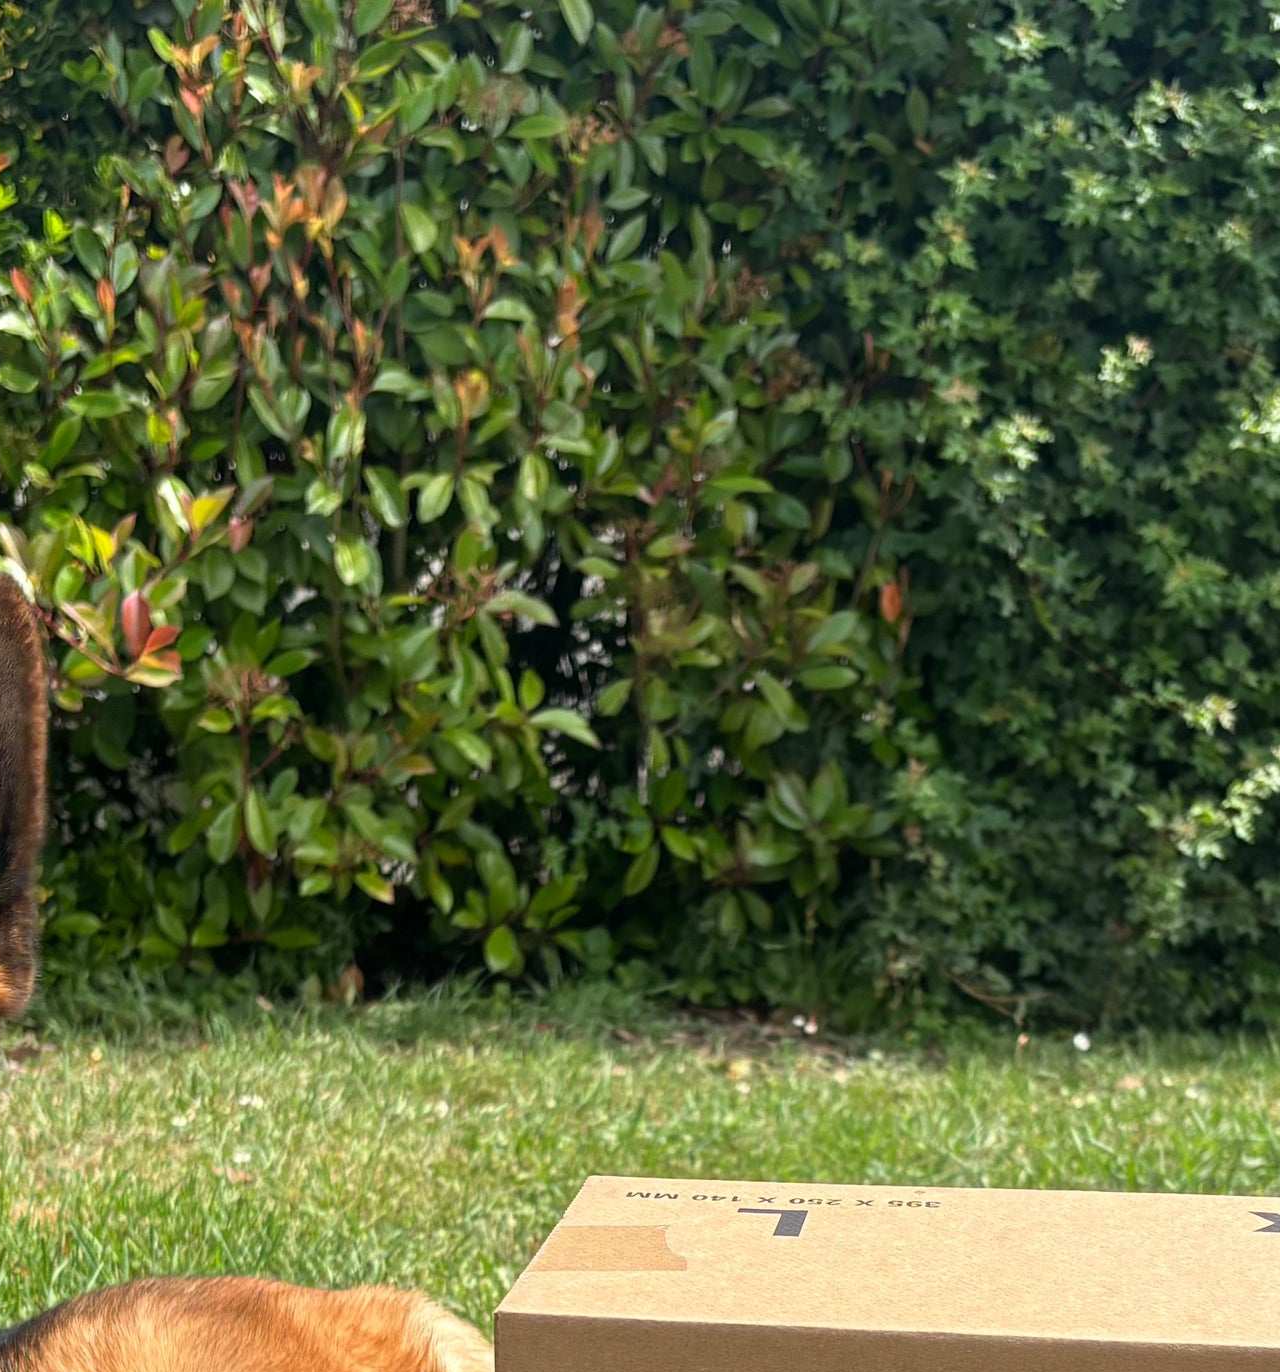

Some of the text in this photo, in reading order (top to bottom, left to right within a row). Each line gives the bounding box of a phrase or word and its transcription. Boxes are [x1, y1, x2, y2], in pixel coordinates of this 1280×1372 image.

[626, 1191, 679, 1200] MM
[692, 1194, 741, 1202] 140
[789, 1197, 841, 1206] 250
[888, 1200, 941, 1208] 395
[737, 1208, 808, 1237] L
